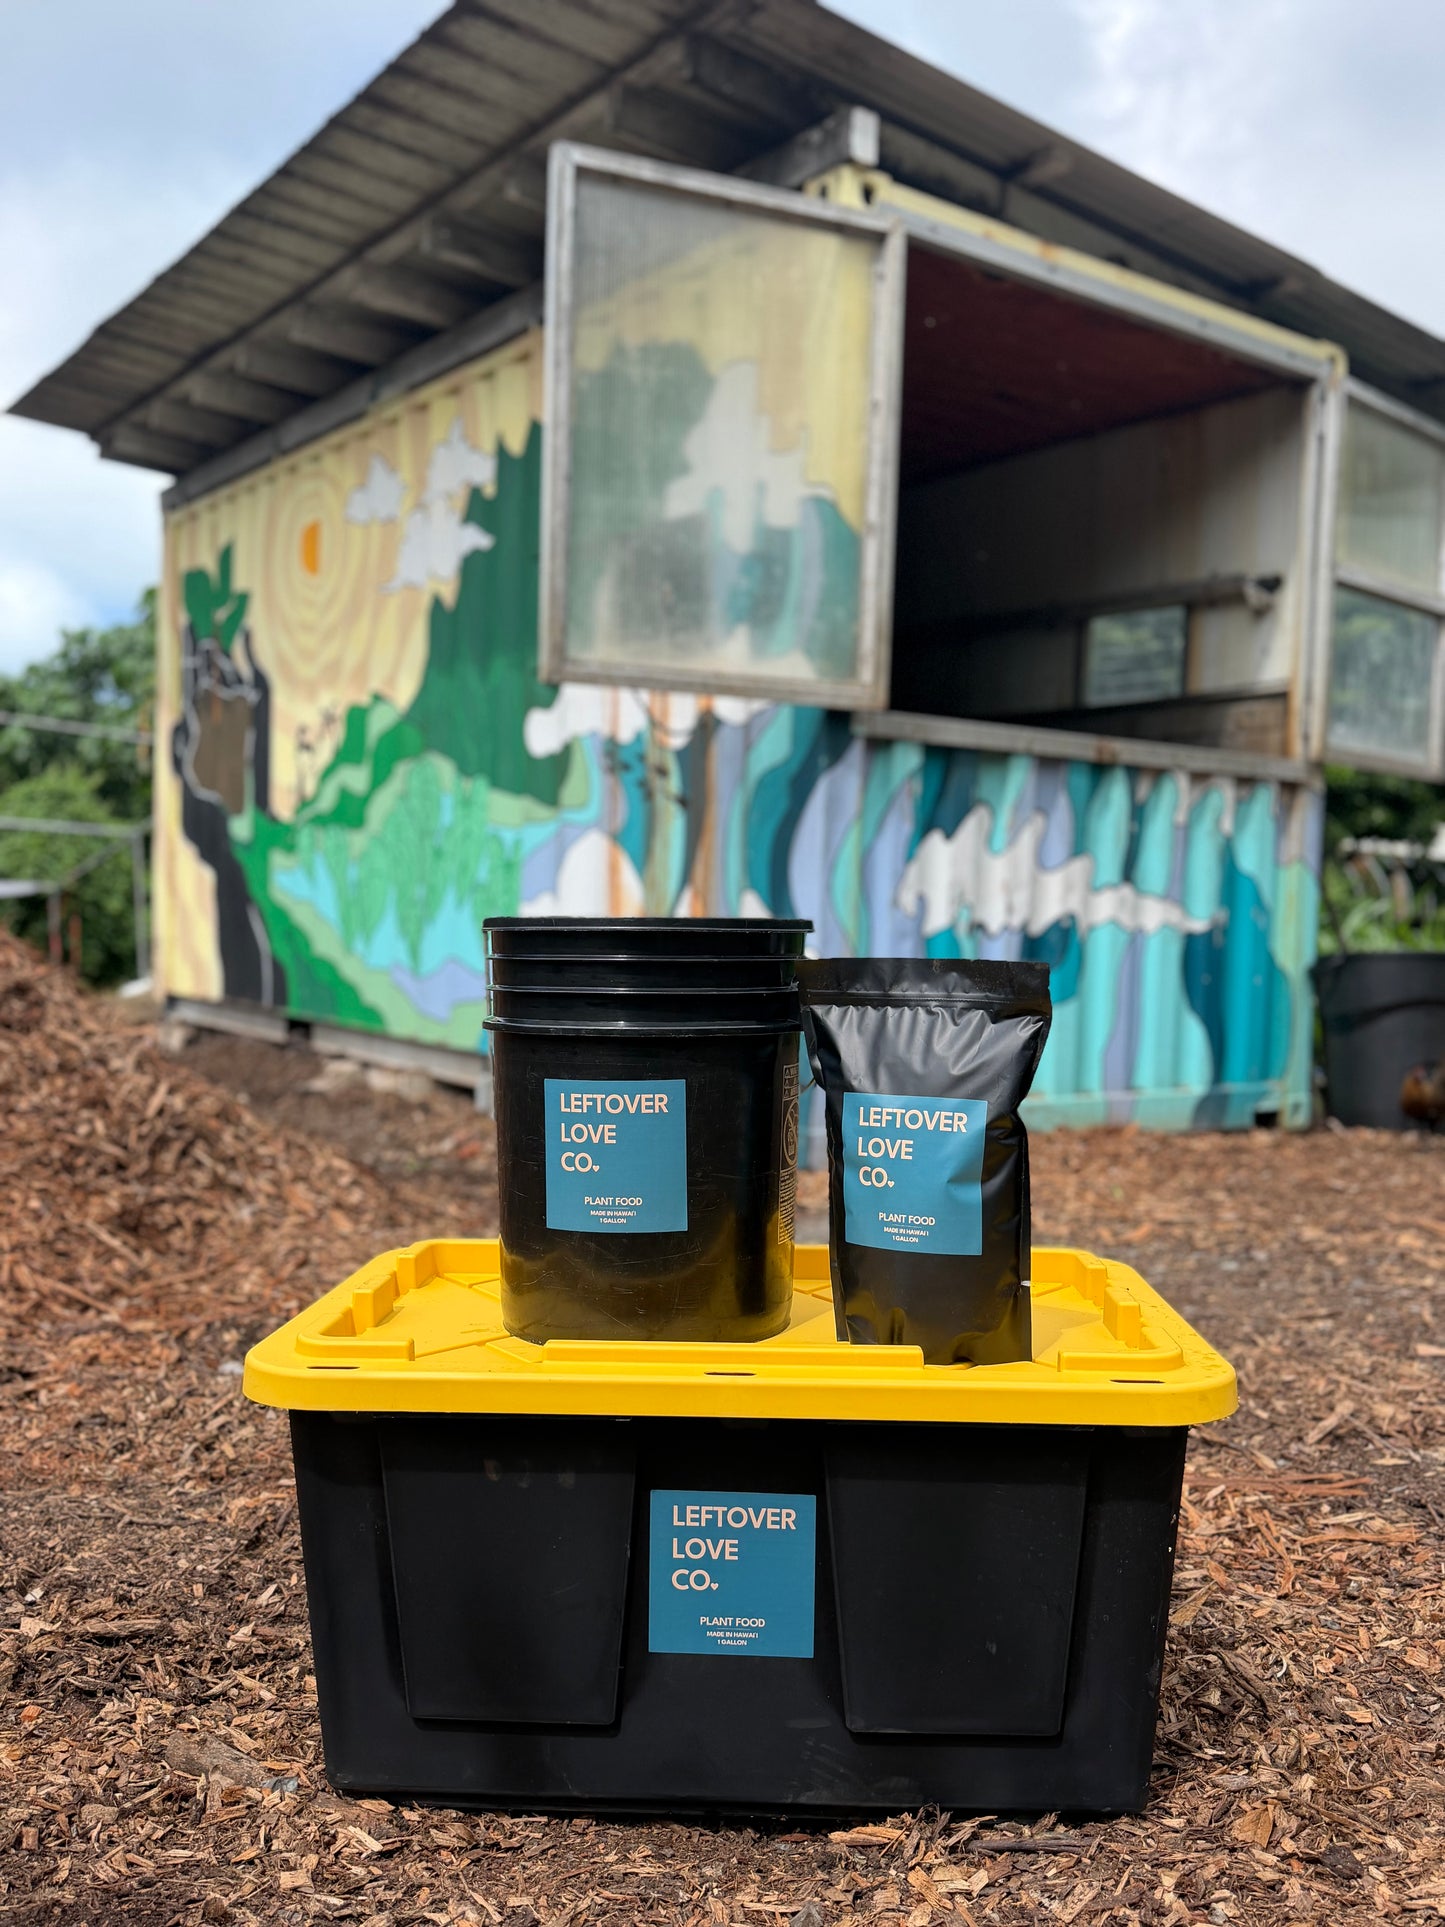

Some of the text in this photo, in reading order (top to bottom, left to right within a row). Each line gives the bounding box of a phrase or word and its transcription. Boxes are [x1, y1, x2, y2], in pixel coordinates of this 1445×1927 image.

[560, 1093, 668, 1114] LEFTOVER
[858, 1107, 968, 1133] LEFTOVER
[560, 1123, 616, 1144] LOVE
[857, 1137, 914, 1160] LOVE
[584, 1197, 643, 1206] PLANT FOOD
[878, 1212, 936, 1226] PLANT FOOD
[895, 1235, 919, 1243] GALLON
[672, 1505, 797, 1530] LEFTOVER
[672, 1537, 739, 1560] LOVE
[700, 1617, 765, 1627] PLANT FOOD
